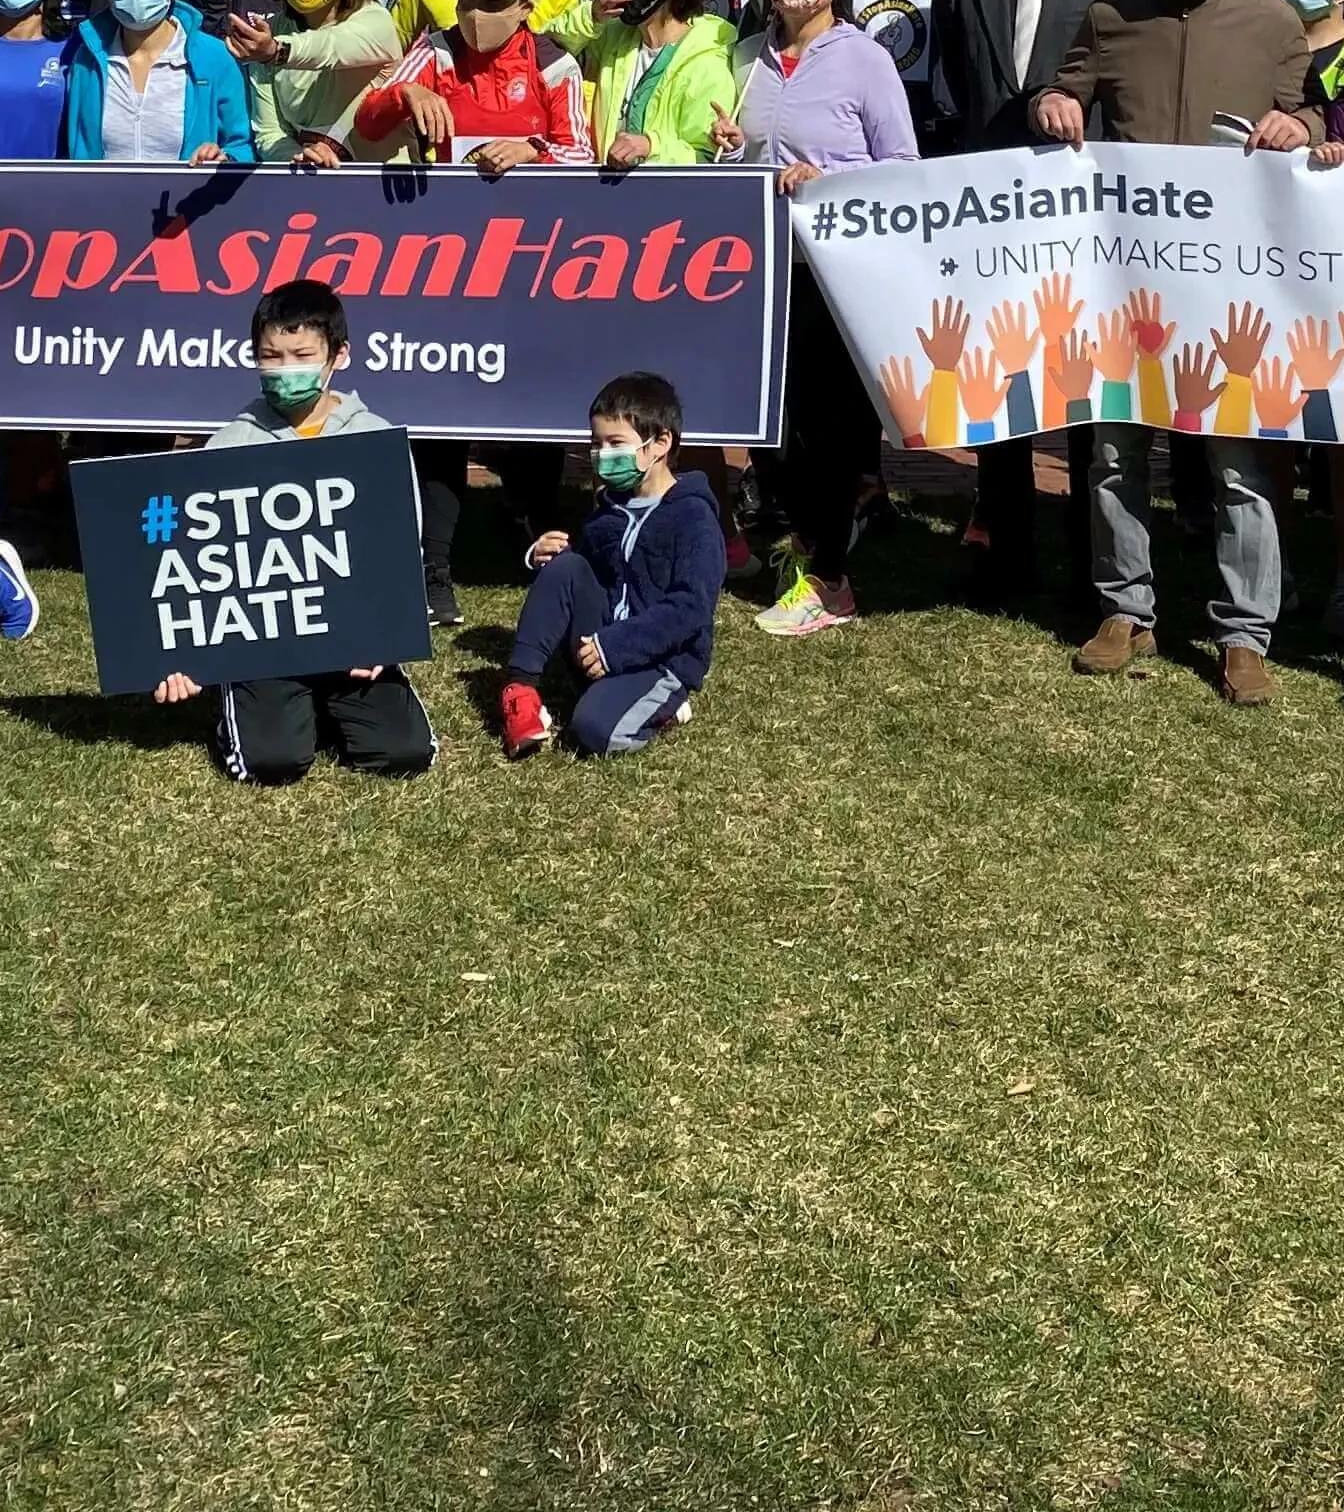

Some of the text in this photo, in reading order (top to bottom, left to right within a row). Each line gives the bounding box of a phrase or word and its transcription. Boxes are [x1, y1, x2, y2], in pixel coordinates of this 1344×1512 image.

[811, 172, 1214, 243] #StopAsianHate
[975, 236, 1084, 279] UNITY
[1093, 235, 1222, 275] MAKES
[1236, 244, 1285, 280] US
[15, 325, 506, 383] Unity Make Strong
[141, 477, 356, 544] #STOP
[151, 530, 352, 599] ASIAN
[157, 586, 329, 650] HATE
